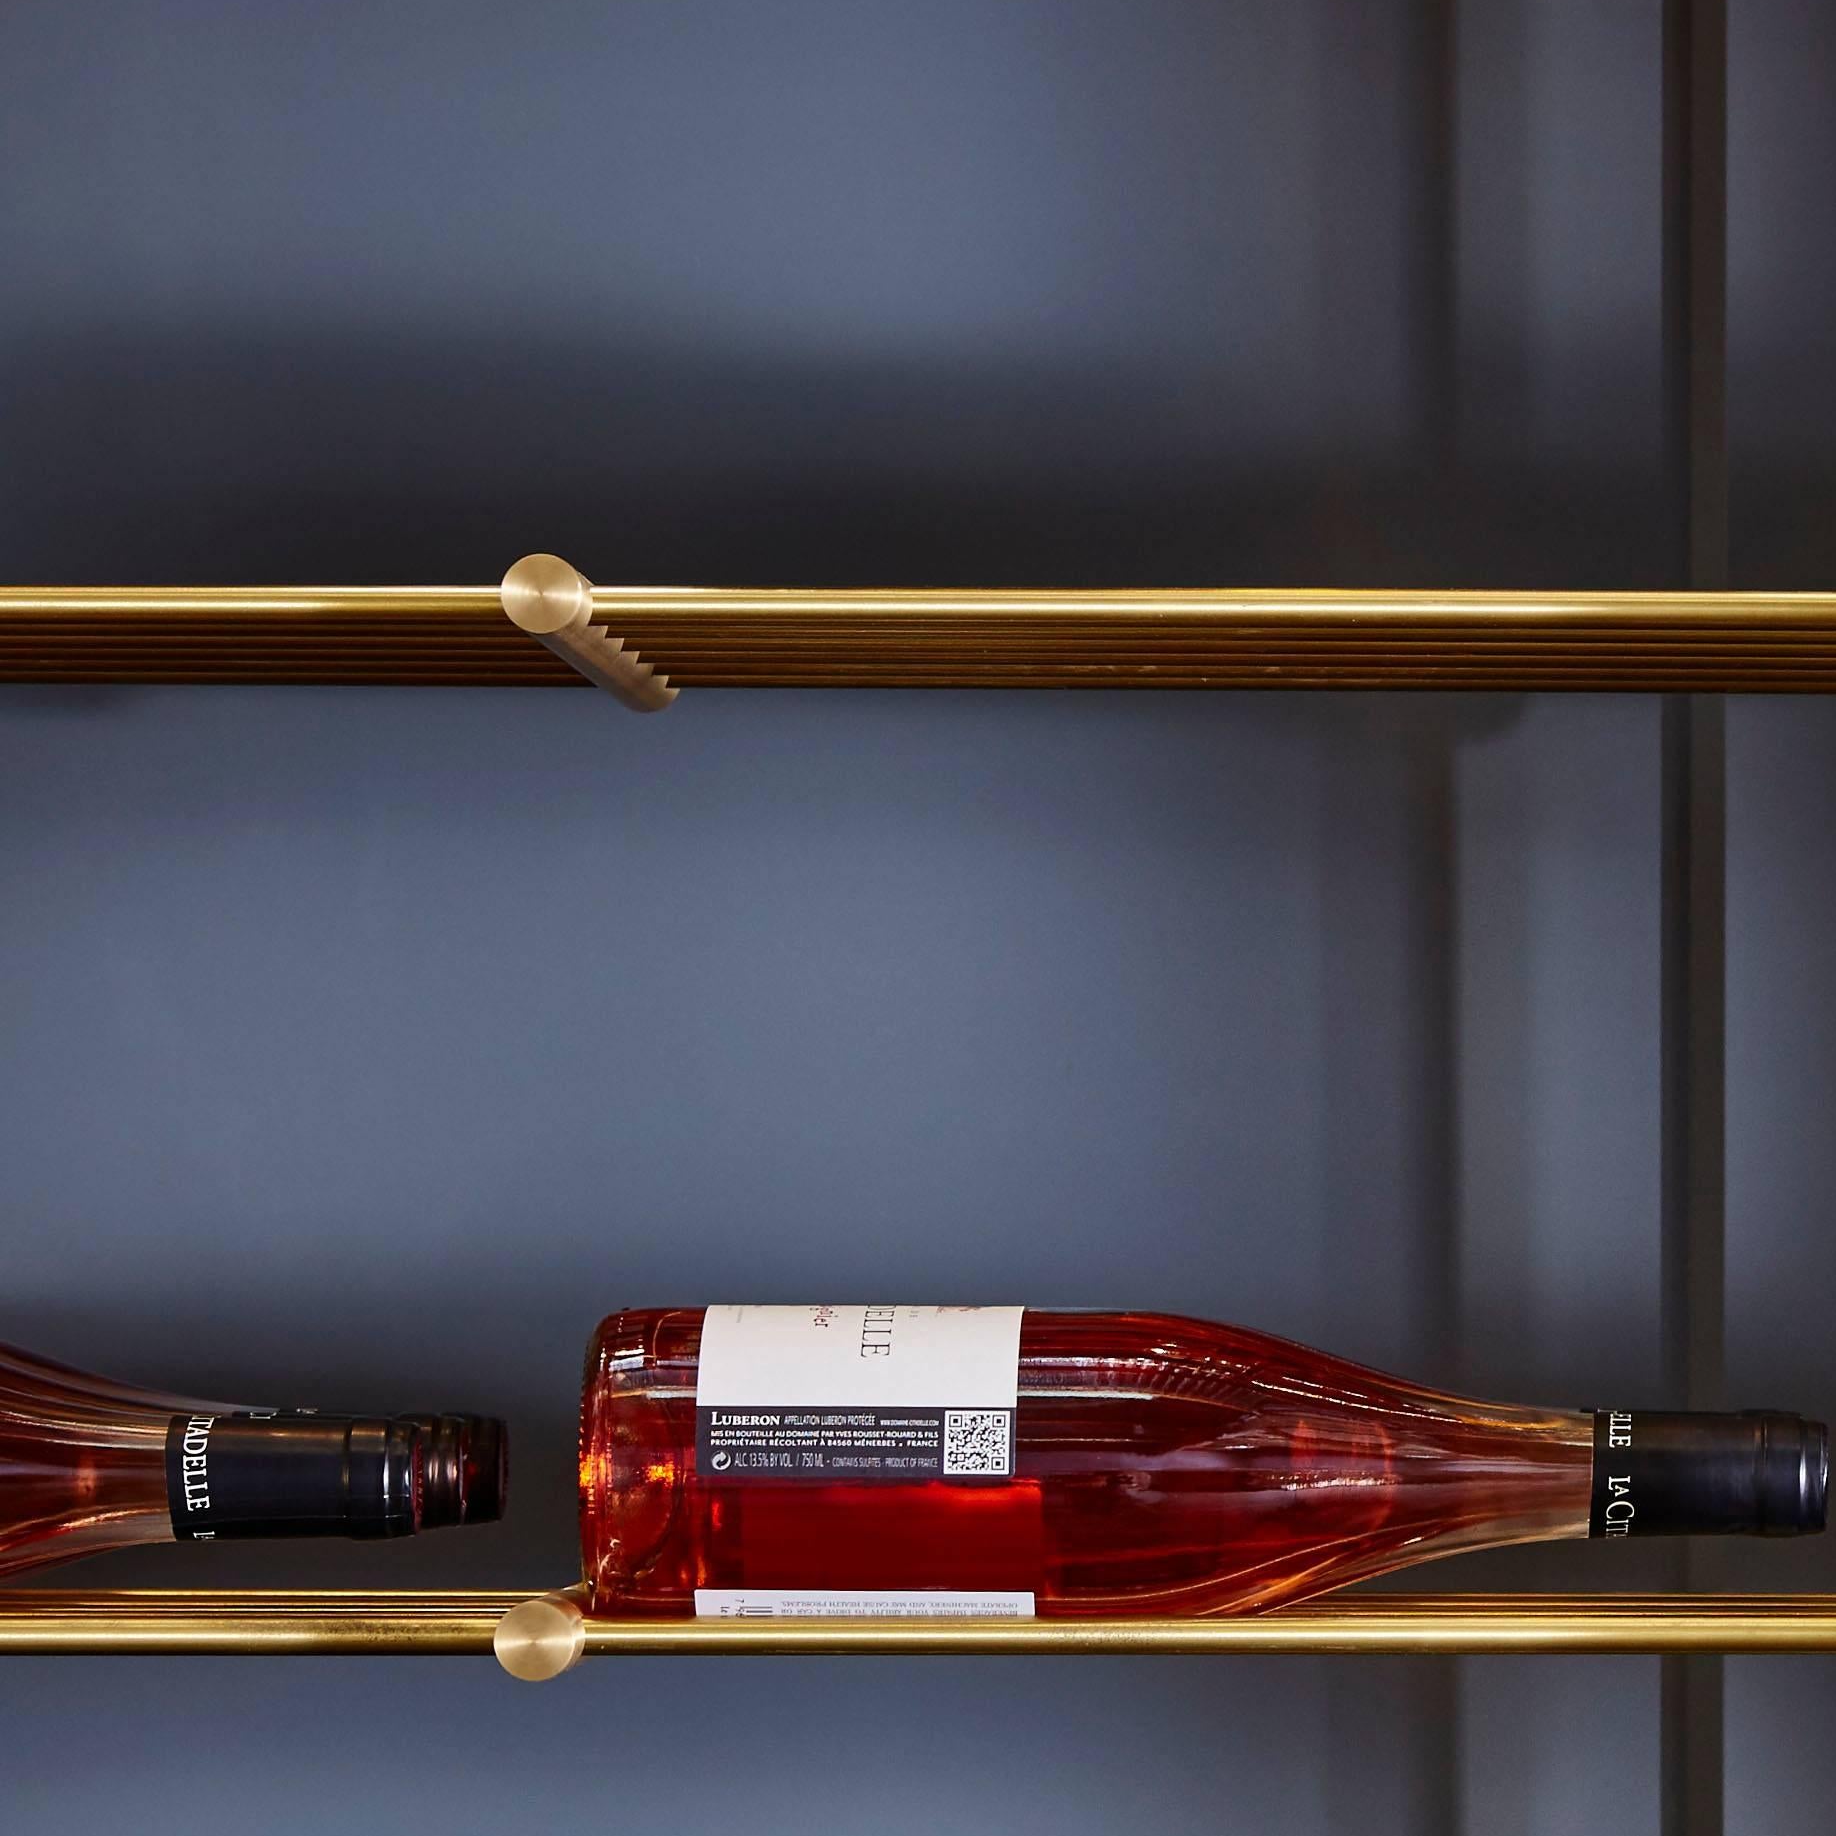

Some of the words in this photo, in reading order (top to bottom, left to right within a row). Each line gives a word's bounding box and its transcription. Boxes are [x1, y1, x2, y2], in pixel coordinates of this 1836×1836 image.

[711, 1411, 780, 1426] LUBERON
[736, 1430, 773, 1438] BOUTEILLE
[774, 1430, 785, 1438] AU
[786, 1430, 820, 1438] DOMAINE
[710, 1438, 767, 1447] PROPRIÉTAIRE
[769, 1438, 818, 1447] RÉCOLTANT
